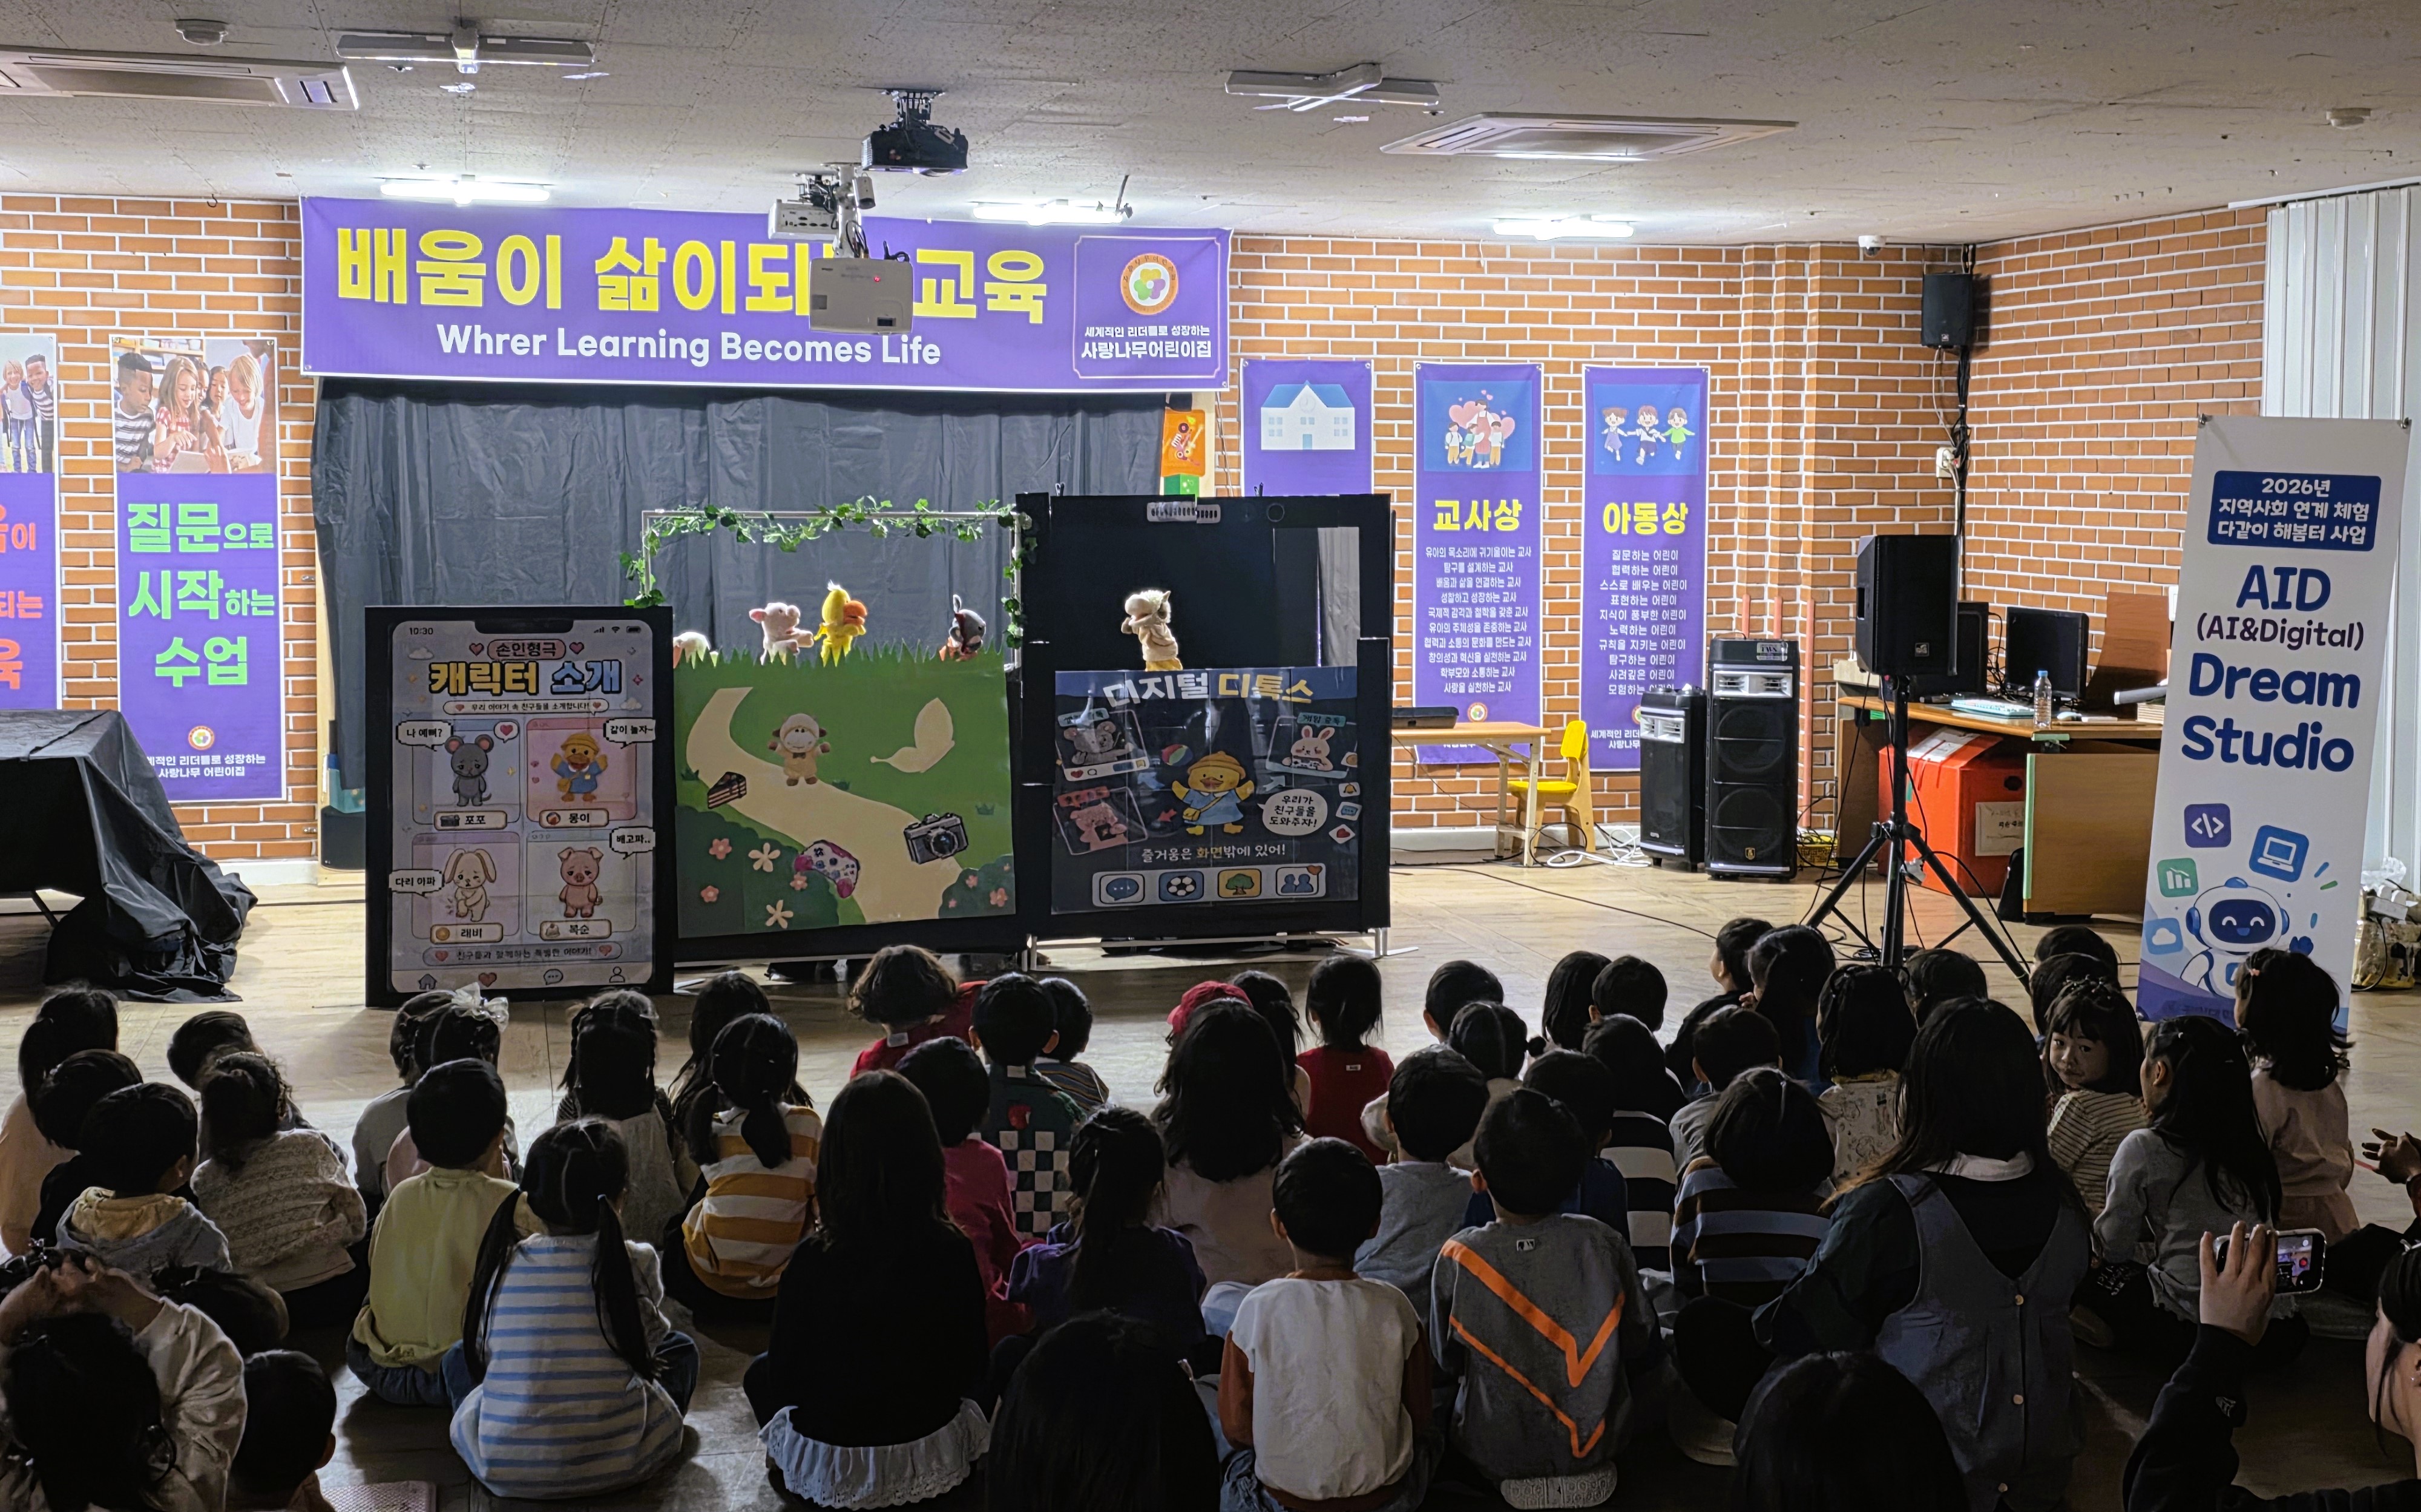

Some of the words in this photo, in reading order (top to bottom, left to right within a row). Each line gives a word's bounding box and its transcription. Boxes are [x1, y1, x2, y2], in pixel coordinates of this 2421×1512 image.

[338, 228, 562, 309] 배움이
[595, 236, 835, 315] 삶이되
[913, 249, 1047, 324] 교육
[1085, 326, 1125, 337] 세계적인
[1128, 326, 1168, 336] 리더들로
[1171, 326, 1210, 336] 성장하는
[436, 324, 547, 355] Whrer
[558, 327, 709, 367] Learning
[721, 332, 871, 363] Becomes
[882, 334, 941, 364] Life
[1082, 341, 1211, 358] 사랑나무어린이집
[2262, 478, 2330, 497] 2026년
[1433, 499, 1522, 531] 교사상
[2219, 499, 2288, 517] 지역사회
[2293, 501, 2328, 519] 연계
[2333, 502, 2369, 522] 체험
[1603, 502, 1688, 535] 아동상
[127, 503, 274, 553] 질문으로
[2218, 521, 2268, 540] 다같이
[2273, 522, 2325, 542] 해봄터
[2330, 525, 2366, 545] 사업
[1426, 547, 1446, 557] 유아의
[1448, 547, 1477, 557] 목소리에
[1479, 547, 1515, 557] 귀기울이는
[1518, 547, 1531, 557] 교사
[1612, 550, 1649, 560] 질문하는
[1654, 550, 1678, 560] 어린이
[1467, 562, 1496, 573] 설계하는
[1498, 562, 1513, 573] 교사
[1612, 565, 1649, 576] 협력하는
[1653, 565, 1677, 576] 어린이
[1436, 577, 1457, 588] 배움과
[1459, 577, 1473, 588] 삶을
[1476, 577, 1505, 588] 연결하는
[1507, 576, 1521, 587] 교사
[1600, 580, 1628, 590] 스스로
[1632, 580, 1659, 591] 배우는
[1663, 579, 1687, 591] 어린이
[2236, 564, 2331, 612] AID
[128, 570, 275, 619] 시작하는
[1471, 592, 1500, 603] 성장하는
[1502, 591, 1516, 602] 교사
[1611, 594, 1648, 605] 표현하는
[1652, 595, 1676, 605] 어린이
[1428, 607, 1450, 618] 국제적
[1451, 607, 1473, 618] 감각과
[1474, 606, 1496, 618] 철학을
[1499, 606, 1513, 617] 갖춘
[1514, 606, 1528, 617] 교사
[1600, 610, 1627, 620] 지식이
[1631, 610, 1658, 620] 풍부한
[1662, 610, 1686, 620] 어린이
[1429, 623, 1450, 633] 유아의
[1453, 622, 1481, 633] 주체성을
[1483, 622, 1511, 633] 존중하는
[1514, 621, 1527, 632] 교사
[1610, 625, 1647, 635] 노력하는
[1651, 625, 1675, 635] 어린이
[2197, 612, 2364, 651] (AI&Digital)
[1424, 637, 1445, 648] 협력과
[1448, 637, 1469, 648] 소통의
[1496, 637, 1516, 648] 만드는
[1517, 636, 1531, 647] 교사
[1599, 639, 1625, 650] 규칙을
[1630, 640, 1657, 650] 지키는
[1661, 639, 1686, 650] 어린이
[496, 642, 557, 657] 손인형극
[155, 637, 248, 687] 수업
[1460, 652, 1481, 663] 혁신을
[1483, 652, 1511, 663] 실천하는
[1513, 651, 1526, 662] 교사
[1609, 654, 1646, 665] 탐구하는
[1650, 654, 1675, 665] 어린이
[429, 661, 539, 696] 캐릭터
[551, 660, 622, 694] 소개
[1440, 668, 1470, 679] 학부모와
[1471, 667, 1499, 678] 소통하는
[1502, 666, 1515, 677] 교사
[1609, 669, 1645, 680] 사려깊은
[1650, 669, 1674, 680] 어린이
[2188, 652, 2360, 709] Dream
[1103, 672, 1209, 707] 디지털
[1218, 674, 1313, 703] 디톡스
[1444, 683, 1465, 693] 사랑을
[1468, 682, 1495, 693] 실천하는
[1497, 682, 1511, 692] 교사
[1609, 685, 1645, 695] 모험하는
[407, 728, 416, 738] 나
[610, 725, 627, 734] 같이
[1591, 730, 1621, 738] 세계적인
[2181, 715, 2354, 773] Studio
[224, 754, 266, 764] 성장하는
[159, 768, 200, 778] 사랑나무
[204, 766, 245, 777] 어린이집
[1281, 795, 1313, 805] 우리가
[1275, 806, 1316, 817] 친구들을
[1269, 816, 1318, 828] 도와주자!
[1142, 849, 1192, 863] 즐거움은
[1255, 844, 1286, 856] 있어!
[395, 877, 413, 886] 다리
[417, 876, 435, 886] 아파
[461, 928, 482, 939] 래비
